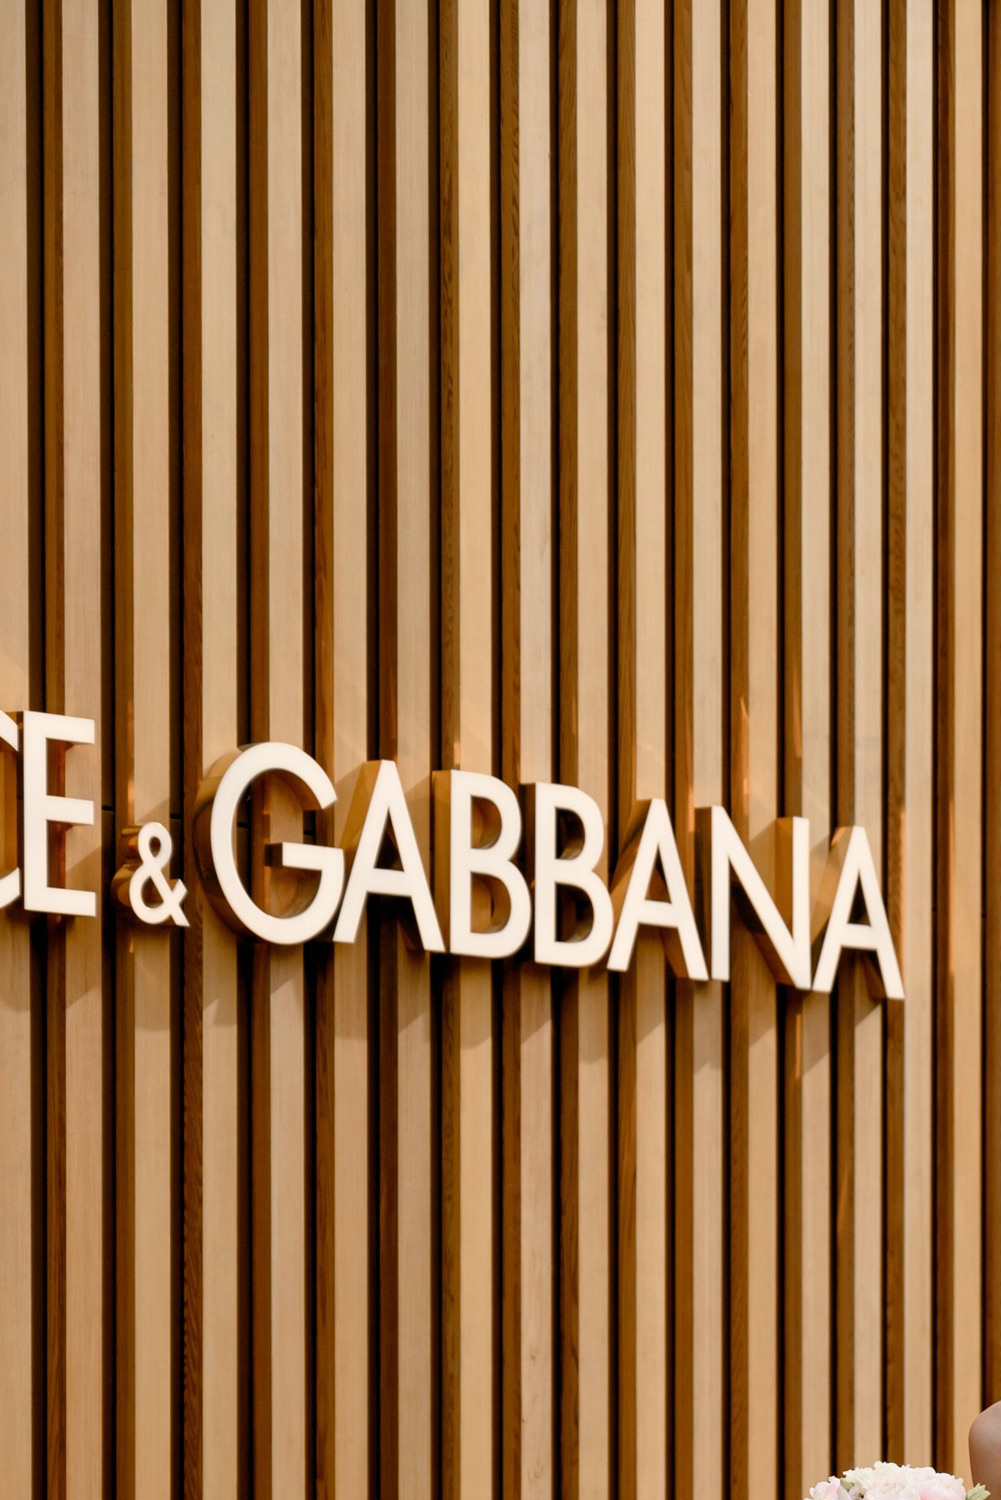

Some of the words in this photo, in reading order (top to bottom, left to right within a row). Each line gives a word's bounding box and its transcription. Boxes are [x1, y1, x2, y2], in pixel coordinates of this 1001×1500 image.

[0, 709, 96, 917] E
[129, 821, 190, 928] &
[209, 741, 906, 1000] GABBANA
